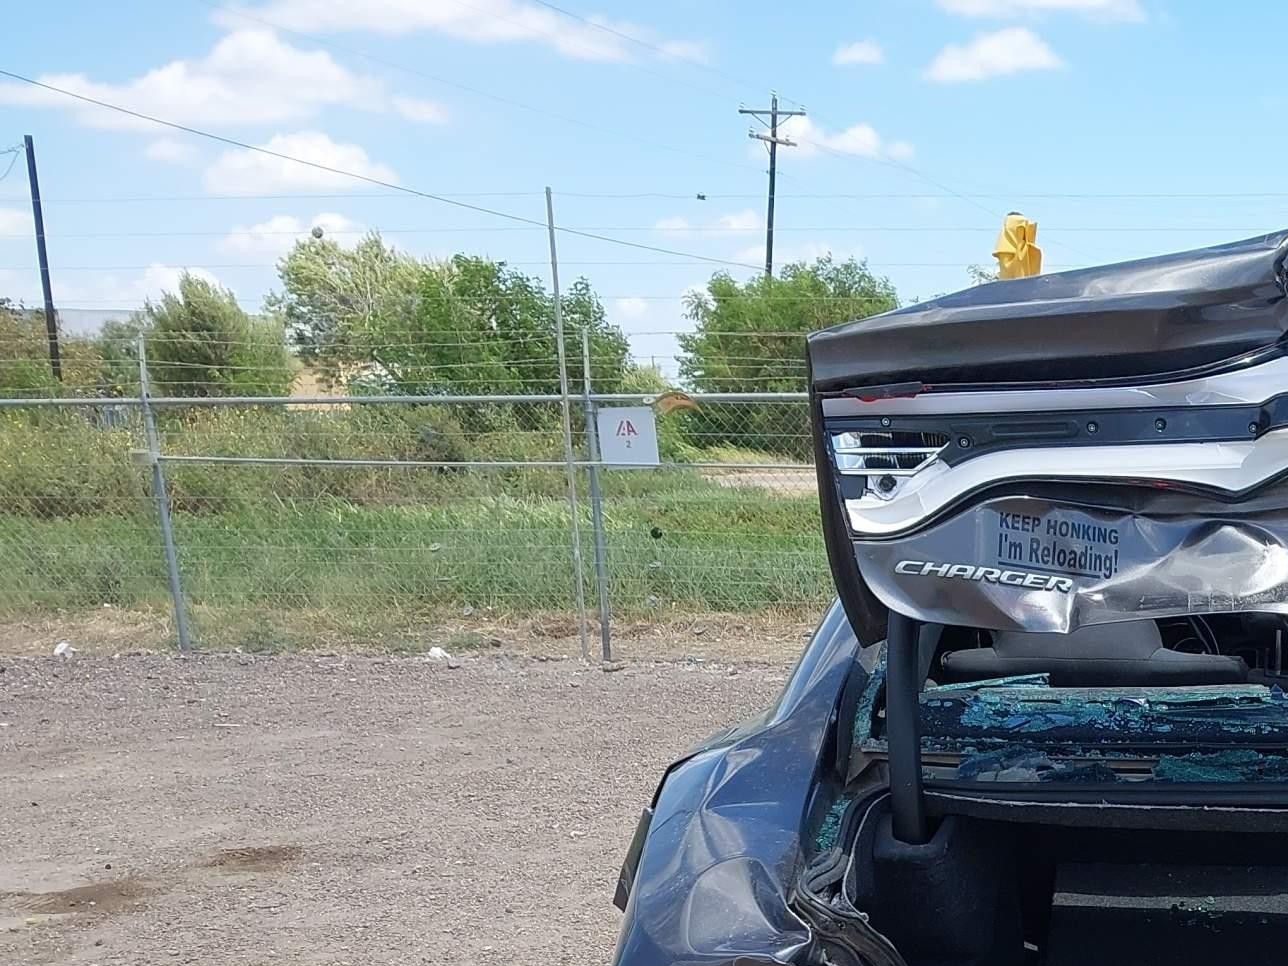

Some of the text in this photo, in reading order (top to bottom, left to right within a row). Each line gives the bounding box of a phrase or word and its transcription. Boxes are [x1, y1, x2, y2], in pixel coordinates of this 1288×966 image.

[999, 511, 1119, 545] KEEP HONKING
[998, 533, 1119, 580] I'm Reloading!
[895, 560, 1073, 593] CHARGER
